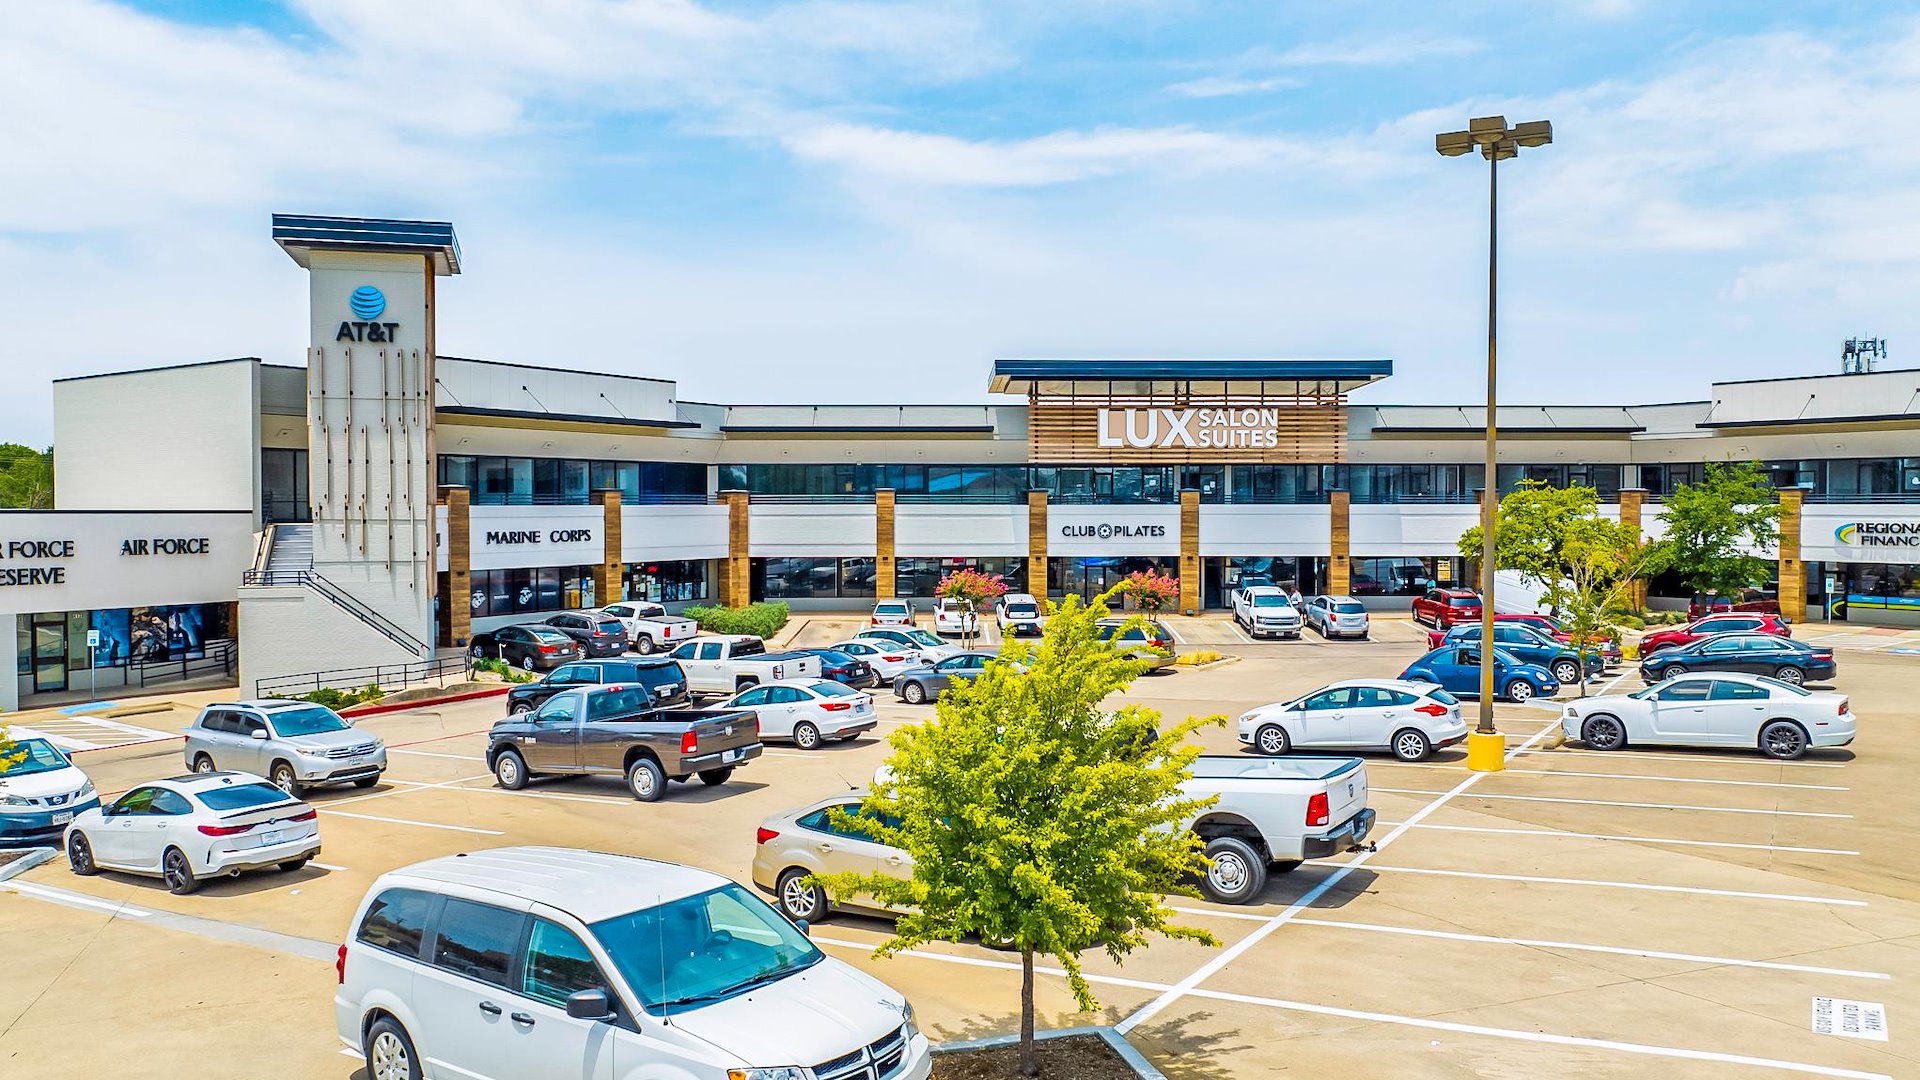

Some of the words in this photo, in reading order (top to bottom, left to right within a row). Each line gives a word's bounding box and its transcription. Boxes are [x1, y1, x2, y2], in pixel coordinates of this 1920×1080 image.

[336, 321, 399, 342] AT&T
[1097, 408, 1198, 448] LUX
[1198, 408, 1279, 427] SALON
[1198, 429, 1279, 448] SUITES
[486, 531, 541, 544] MARINE
[549, 529, 592, 543] CORPS
[1061, 525, 1096, 537] CLUB
[1114, 525, 1166, 537] PILATES
[9, 540, 75, 558] FORCE
[120, 539, 149, 556] AIR
[153, 538, 210, 554] FORCE
[1861, 535, 1920, 547] FINANC
